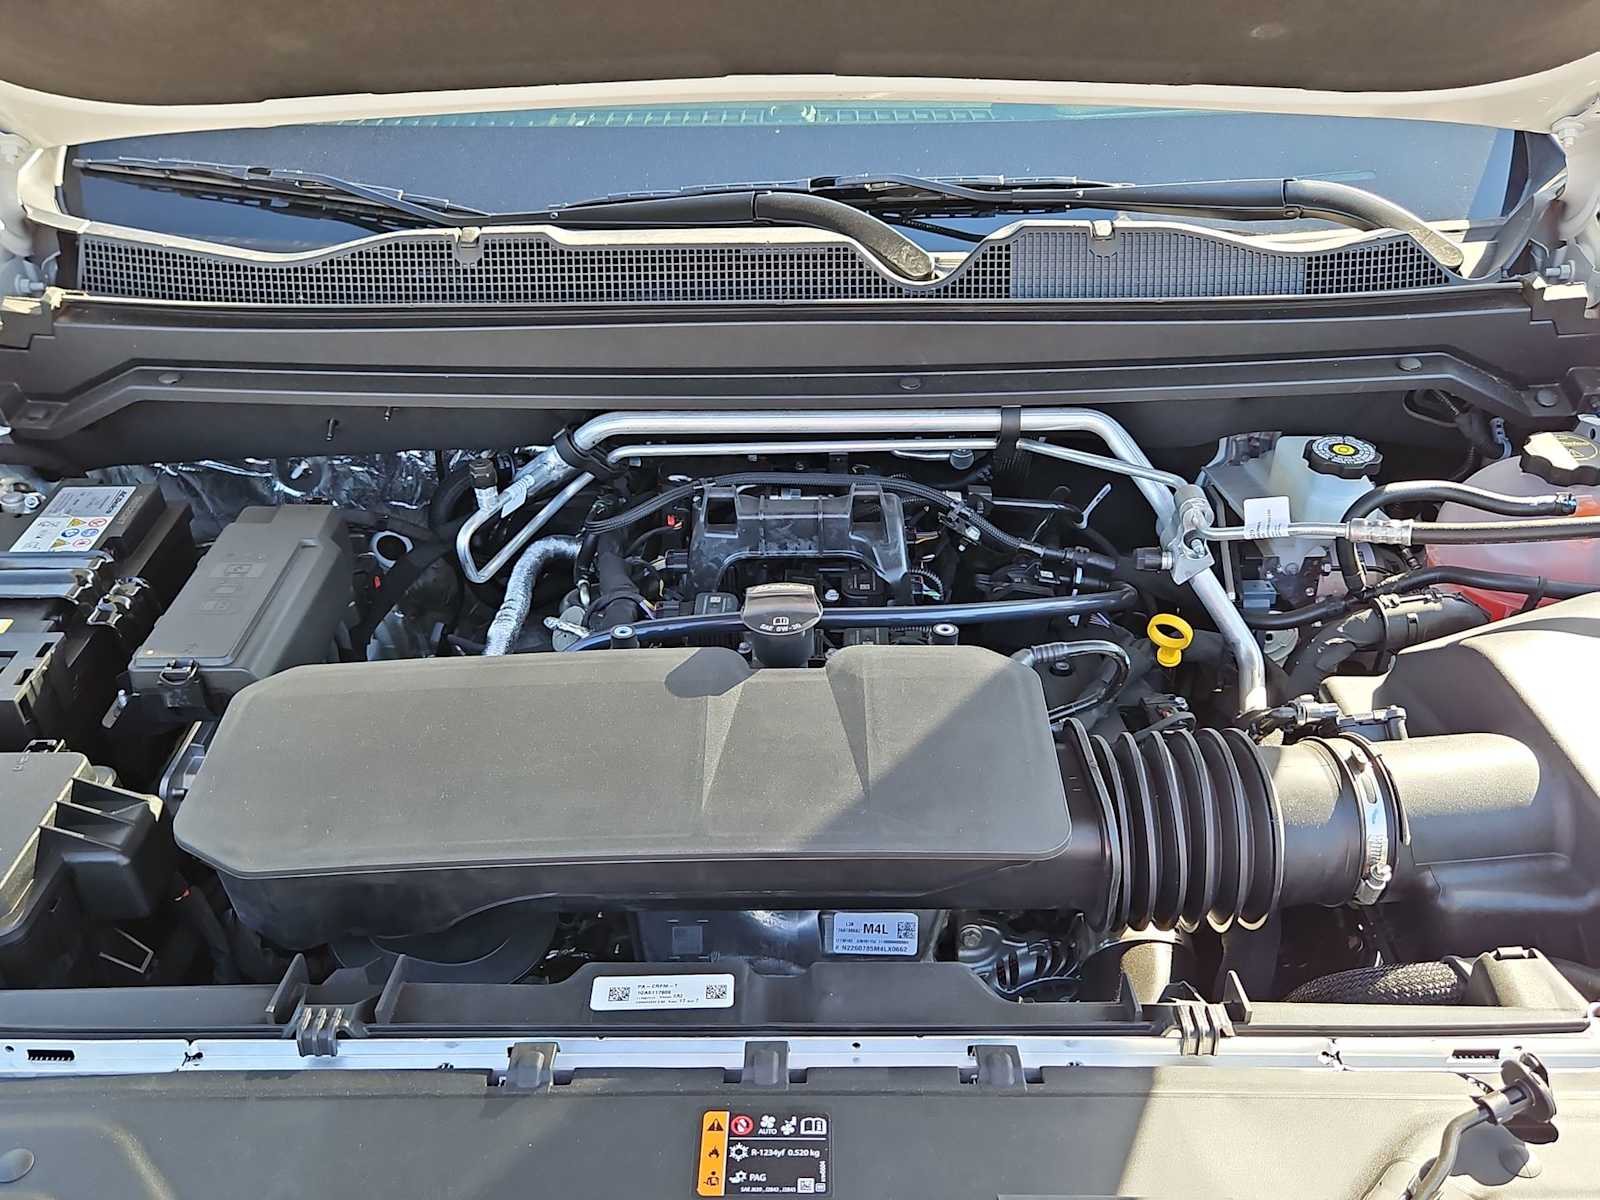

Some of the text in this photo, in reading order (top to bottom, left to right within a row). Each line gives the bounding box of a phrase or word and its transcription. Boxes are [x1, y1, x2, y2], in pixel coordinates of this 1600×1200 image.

[863, 923, 888, 935] M4L
[751, 1148, 820, 1158] R-1234yf 0.520 kg
[749, 1173, 767, 1181] PAG
